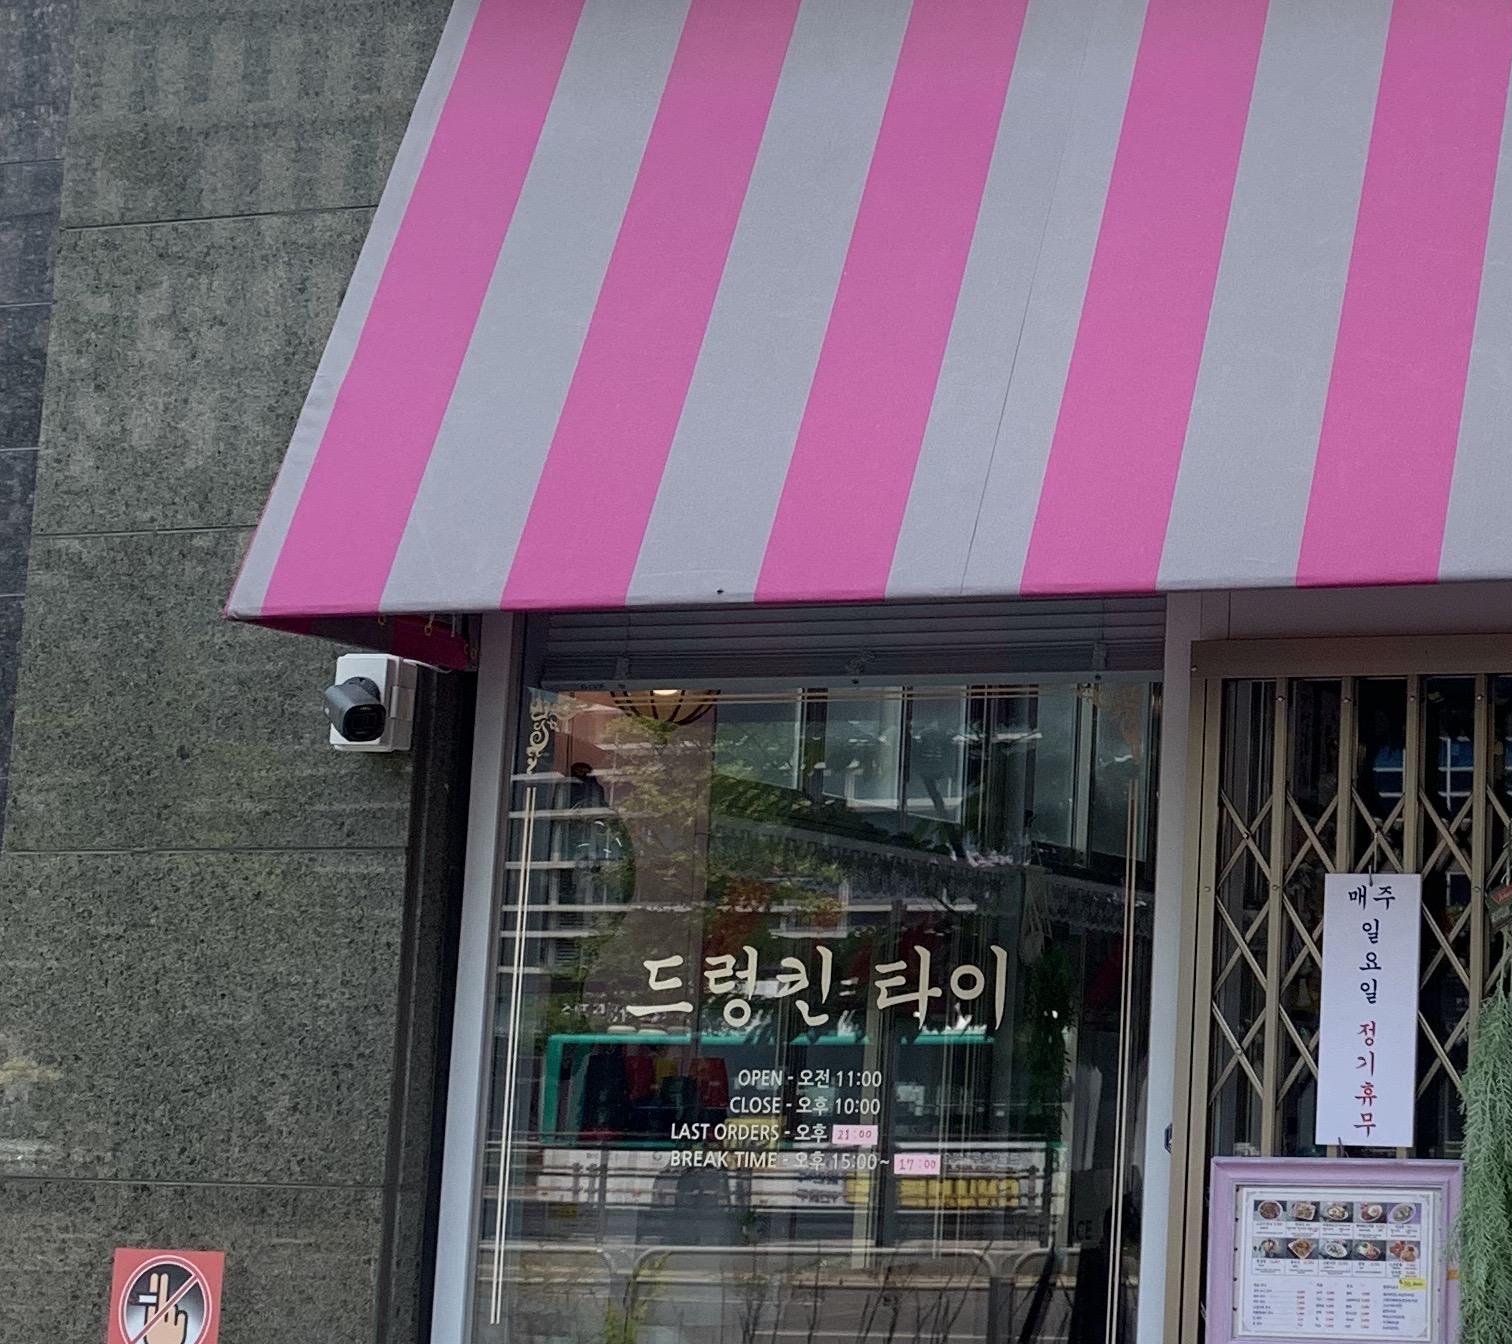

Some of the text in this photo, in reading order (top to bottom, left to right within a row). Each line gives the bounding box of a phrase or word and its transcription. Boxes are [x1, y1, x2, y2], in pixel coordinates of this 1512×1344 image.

[1347, 885, 1396, 911] 매주
[1358, 917, 1382, 1005] 일요일
[738, 1069, 783, 1087] OPEN
[797, 1068, 830, 1089] 오전
[836, 1070, 882, 1087] 11:00
[729, 1096, 781, 1115] CLOSE
[796, 1096, 829, 1116] 오후
[835, 1098, 880, 1115] 10:00
[671, 1122, 711, 1140] LAST
[714, 1123, 780, 1142] ORDERS
[794, 1123, 828, 1143] 오후
[670, 1151, 729, 1169] BREAK
[733, 1152, 778, 1169] TIME
[793, 1150, 826, 1171] 오후
